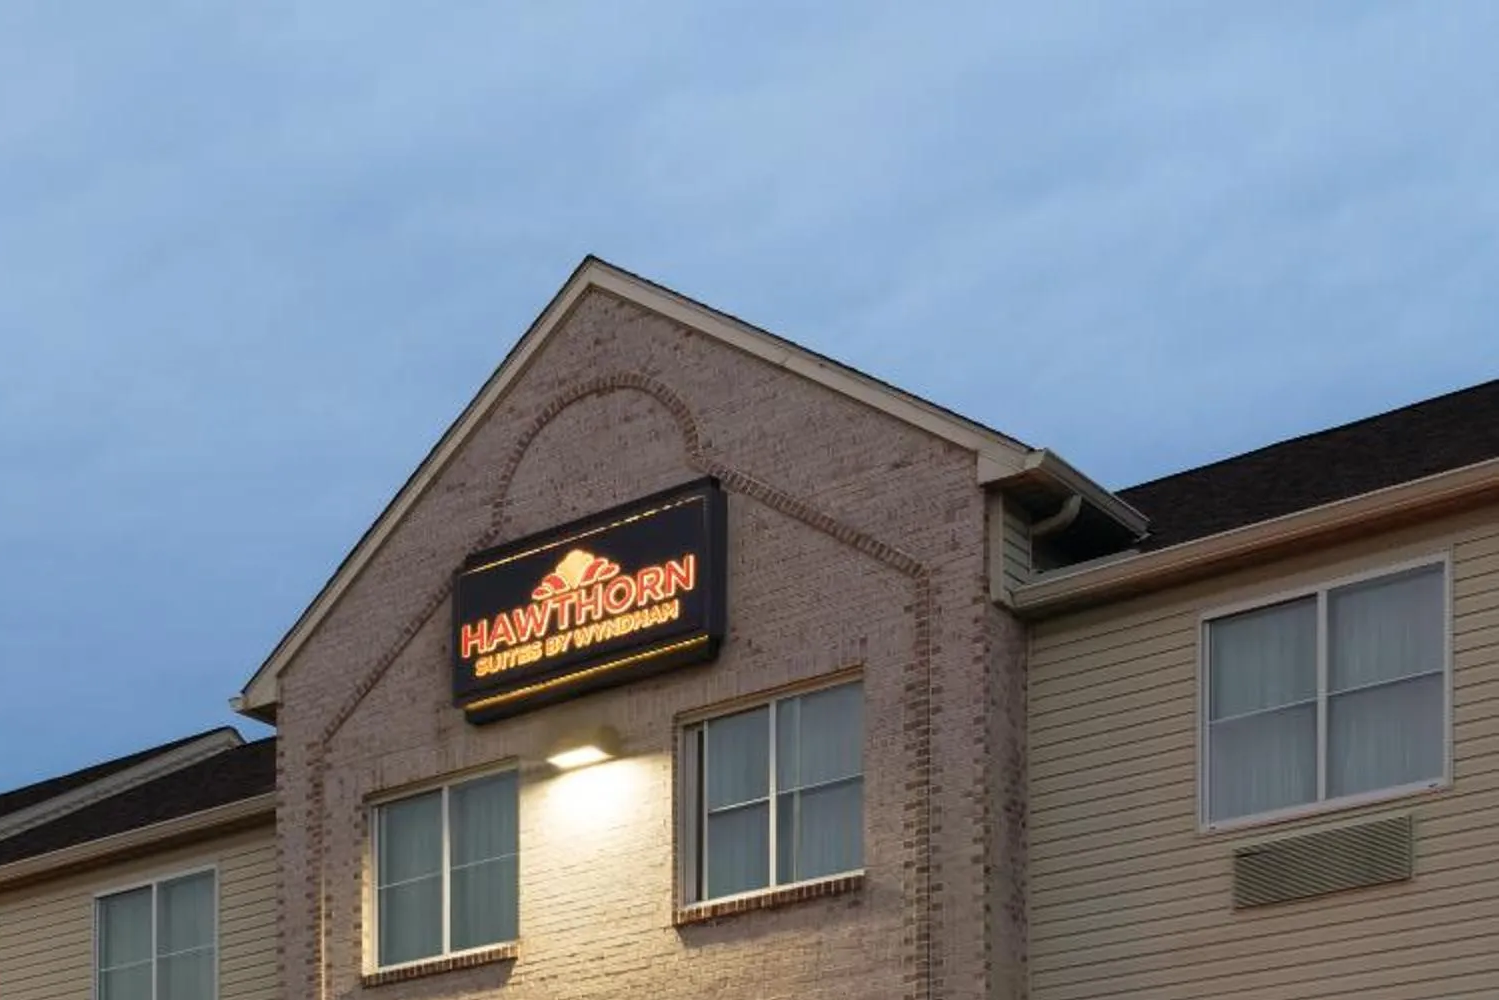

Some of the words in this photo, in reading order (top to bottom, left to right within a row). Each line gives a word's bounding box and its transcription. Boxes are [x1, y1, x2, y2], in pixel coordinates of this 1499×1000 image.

[461, 554, 694, 658] HAWTHORN
[475, 641, 543, 676] SUITES
[545, 631, 573, 656] BY
[573, 599, 679, 648] WYNDHAM
